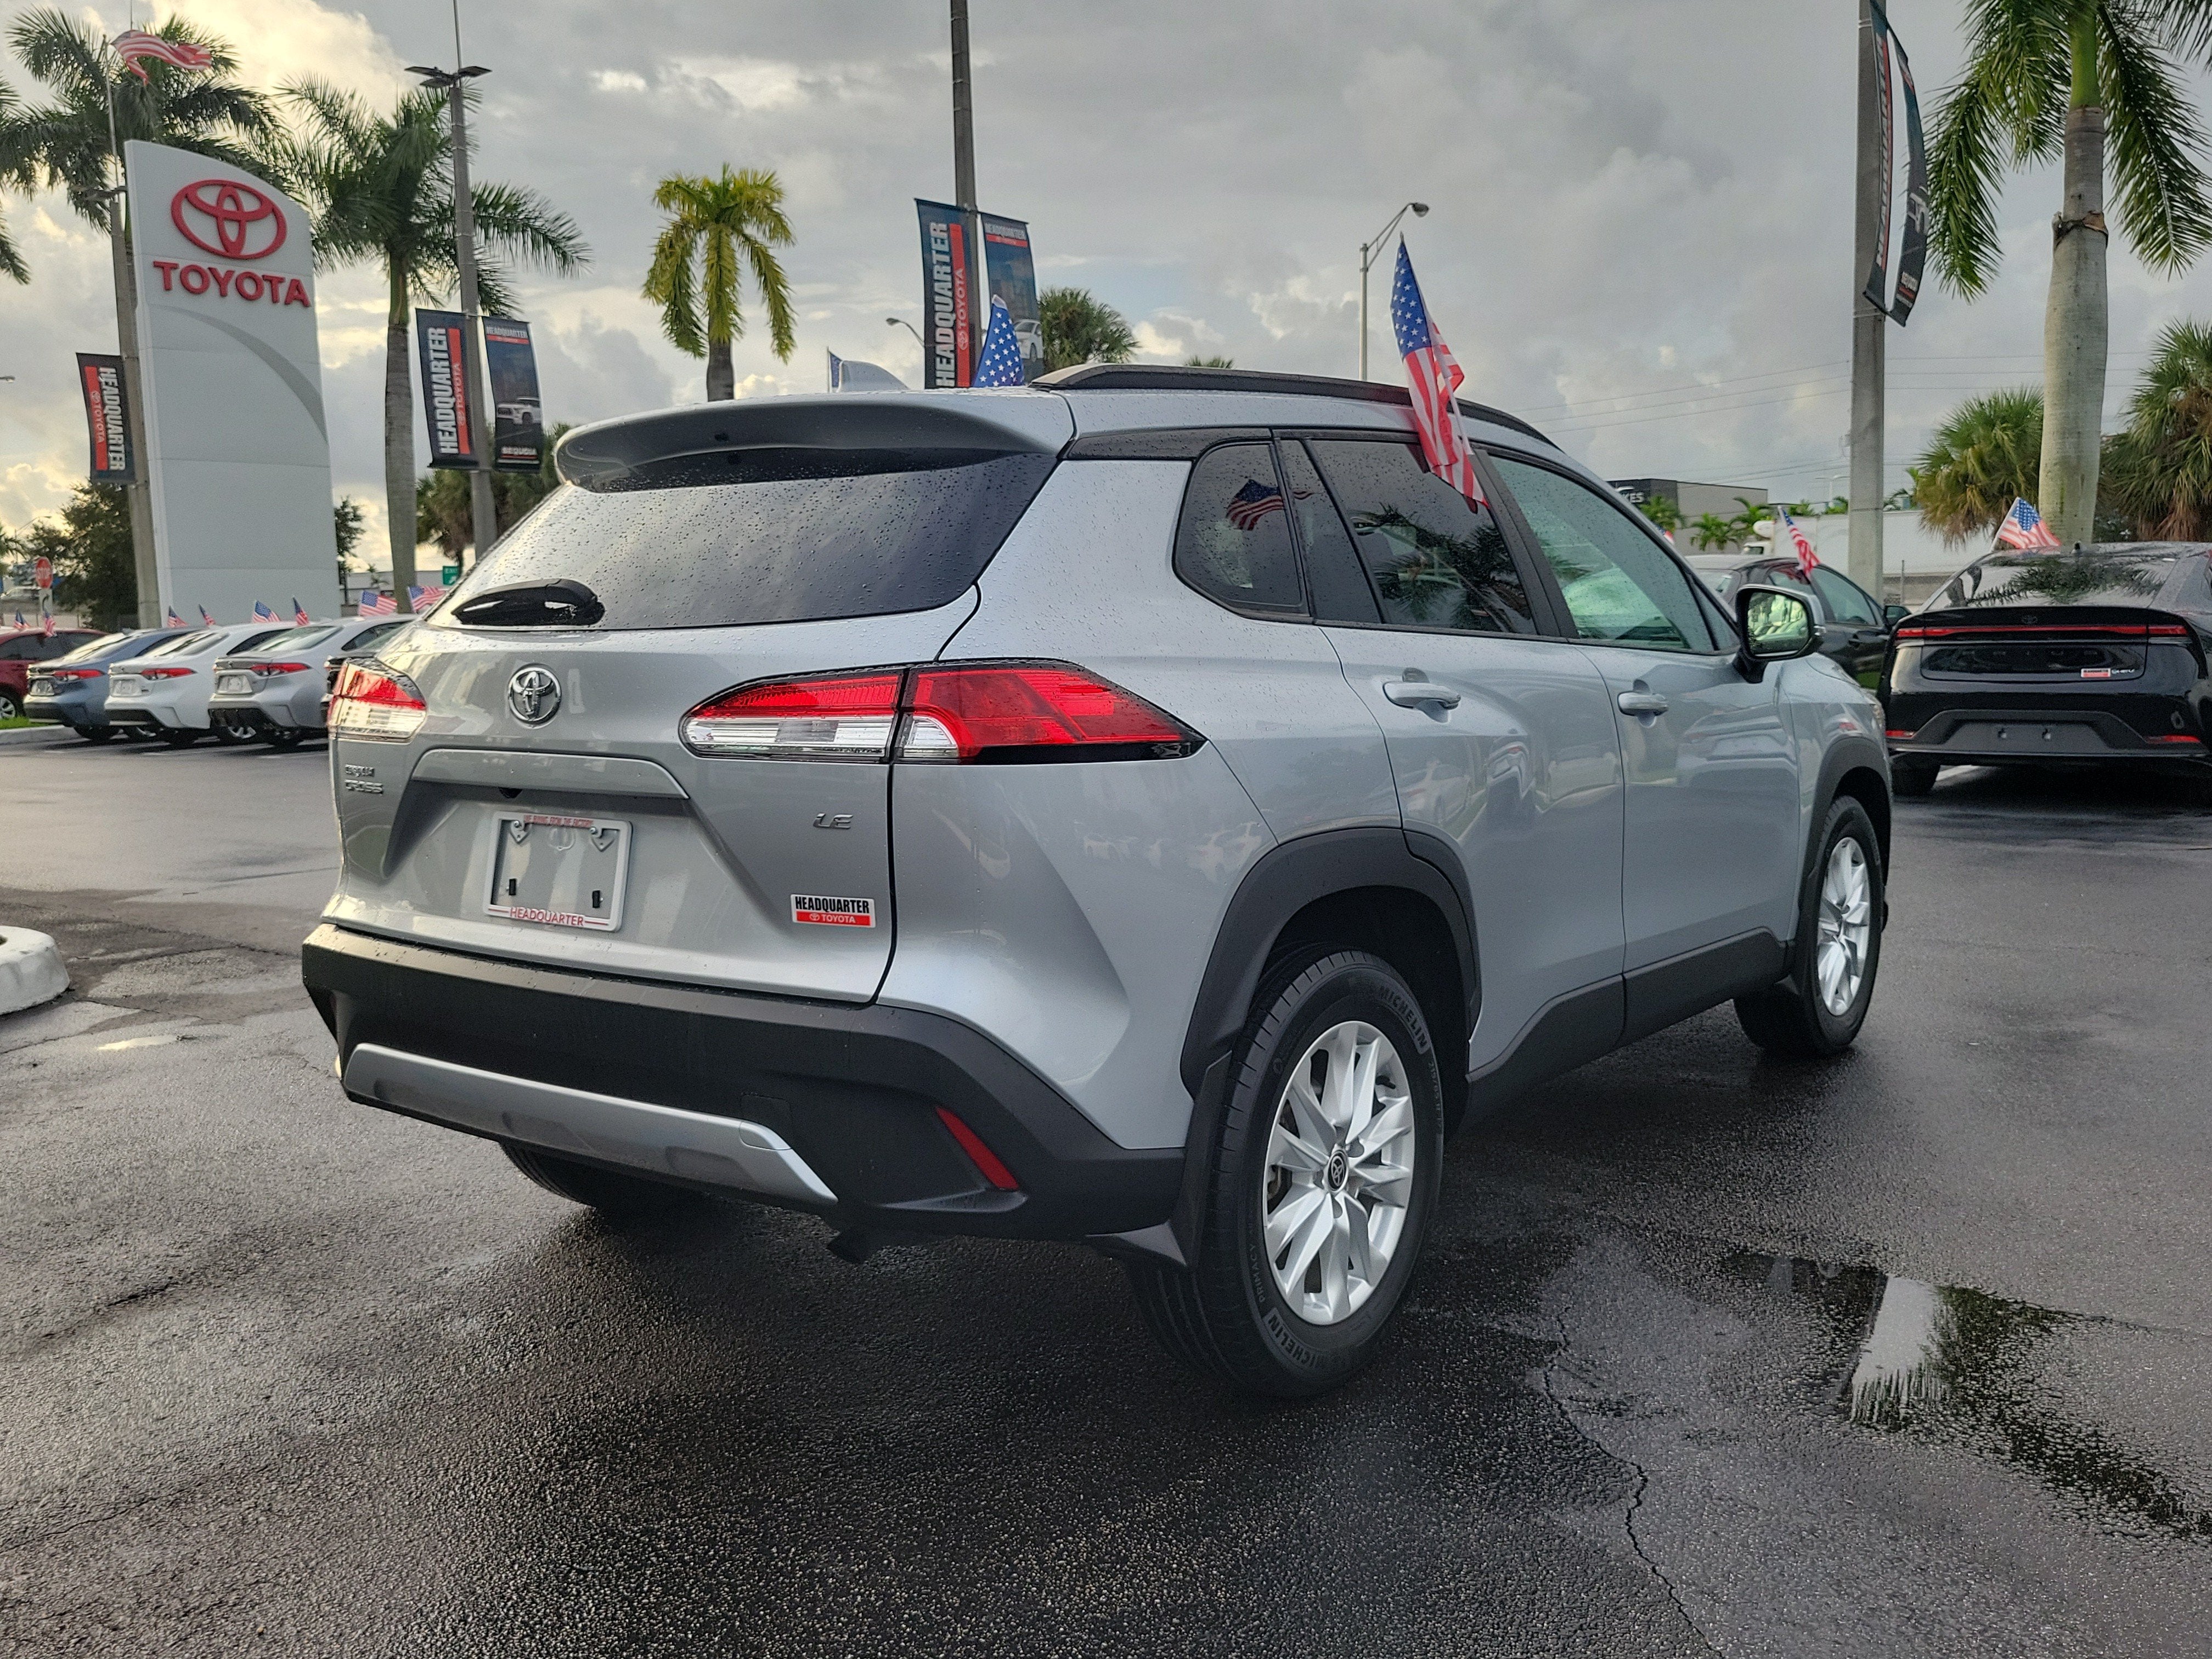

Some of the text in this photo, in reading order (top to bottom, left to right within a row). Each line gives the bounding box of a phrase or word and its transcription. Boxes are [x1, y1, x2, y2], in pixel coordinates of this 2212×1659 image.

[153, 261, 311, 307] TOYOTA
[929, 222, 956, 387] HEADQUARTER
[956, 268, 967, 329] TOYOTA
[428, 327, 459, 454] HEADQUARTER
[93, 404, 105, 443] TOYOTA
[98, 366, 126, 471] HEADQUARTER
[345, 780, 383, 794] CROSS
[813, 812, 854, 830] LE
[510, 906, 584, 926] HEADQUARTER
[795, 896, 870, 913] HEADQUARTER
[822, 915, 856, 923] TOYOTA
[1379, 985, 1427, 1048] MICHELIN
[1249, 1243, 1266, 1304] PRIMACY
